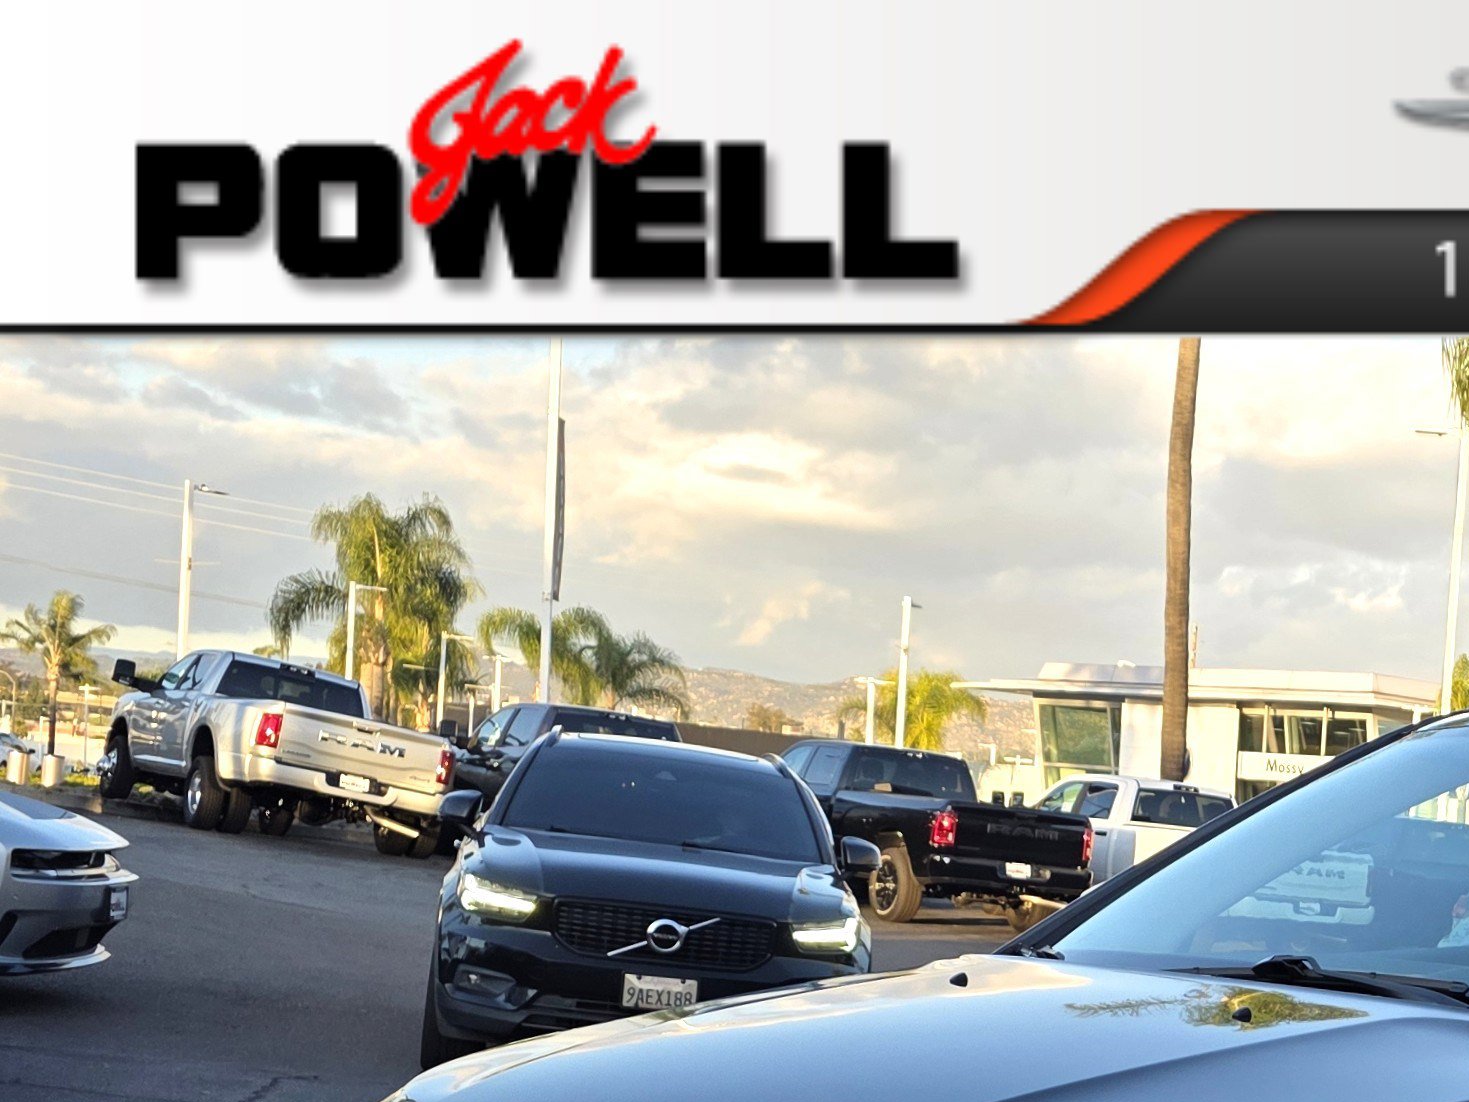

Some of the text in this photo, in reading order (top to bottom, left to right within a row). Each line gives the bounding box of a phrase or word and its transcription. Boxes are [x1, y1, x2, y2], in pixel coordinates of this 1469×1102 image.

[318, 729, 407, 758] RAM
[987, 822, 1059, 840] RAM
[626, 986, 693, 1007] 9AEX188
